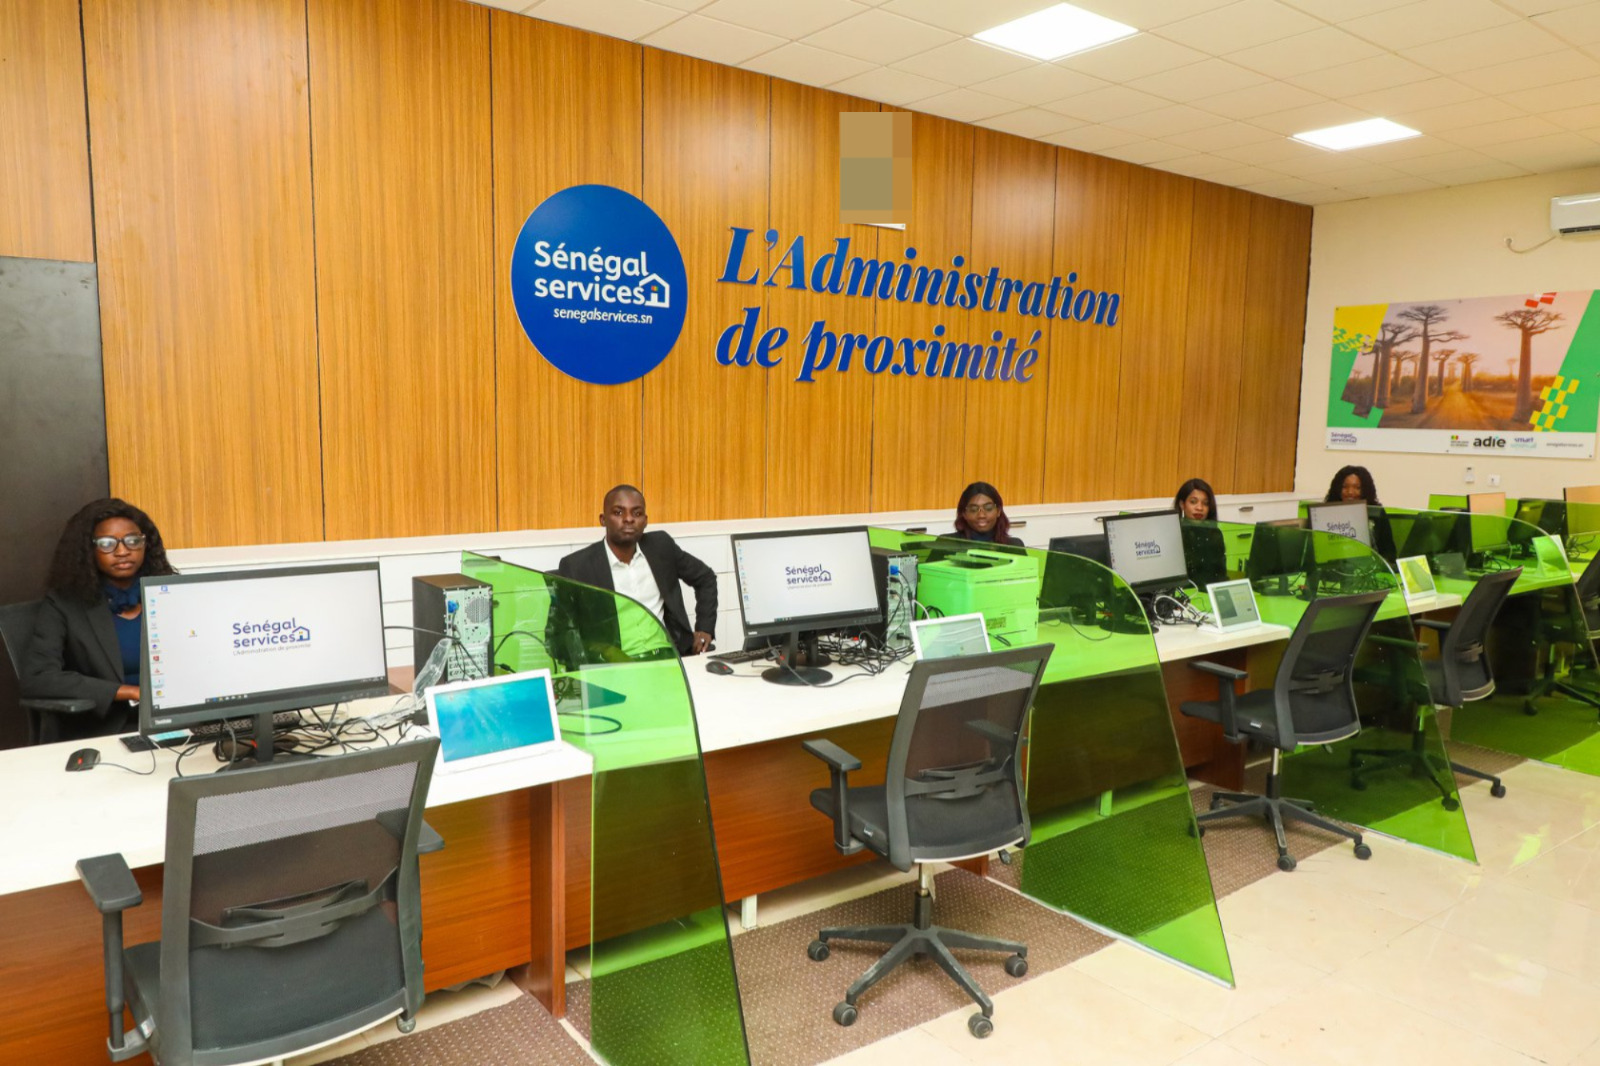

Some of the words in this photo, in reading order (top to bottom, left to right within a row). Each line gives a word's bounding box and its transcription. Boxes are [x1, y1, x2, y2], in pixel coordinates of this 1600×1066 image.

[534, 240, 649, 281] Sénégal
[716, 226, 1120, 327] L’Administration
[534, 275, 646, 305] services
[553, 307, 653, 324] senegalservices.sn
[715, 306, 789, 367] de
[794, 319, 1042, 383] proximité
[1473, 436, 1506, 448] adie
[1326, 521, 1351, 531] Sénégal
[1134, 540, 1155, 549] Sénégal
[1136, 548, 1155, 556] services
[785, 563, 822, 575] Sénégal
[787, 574, 823, 584] services
[232, 617, 296, 635] Sénégal
[233, 633, 296, 648] services
